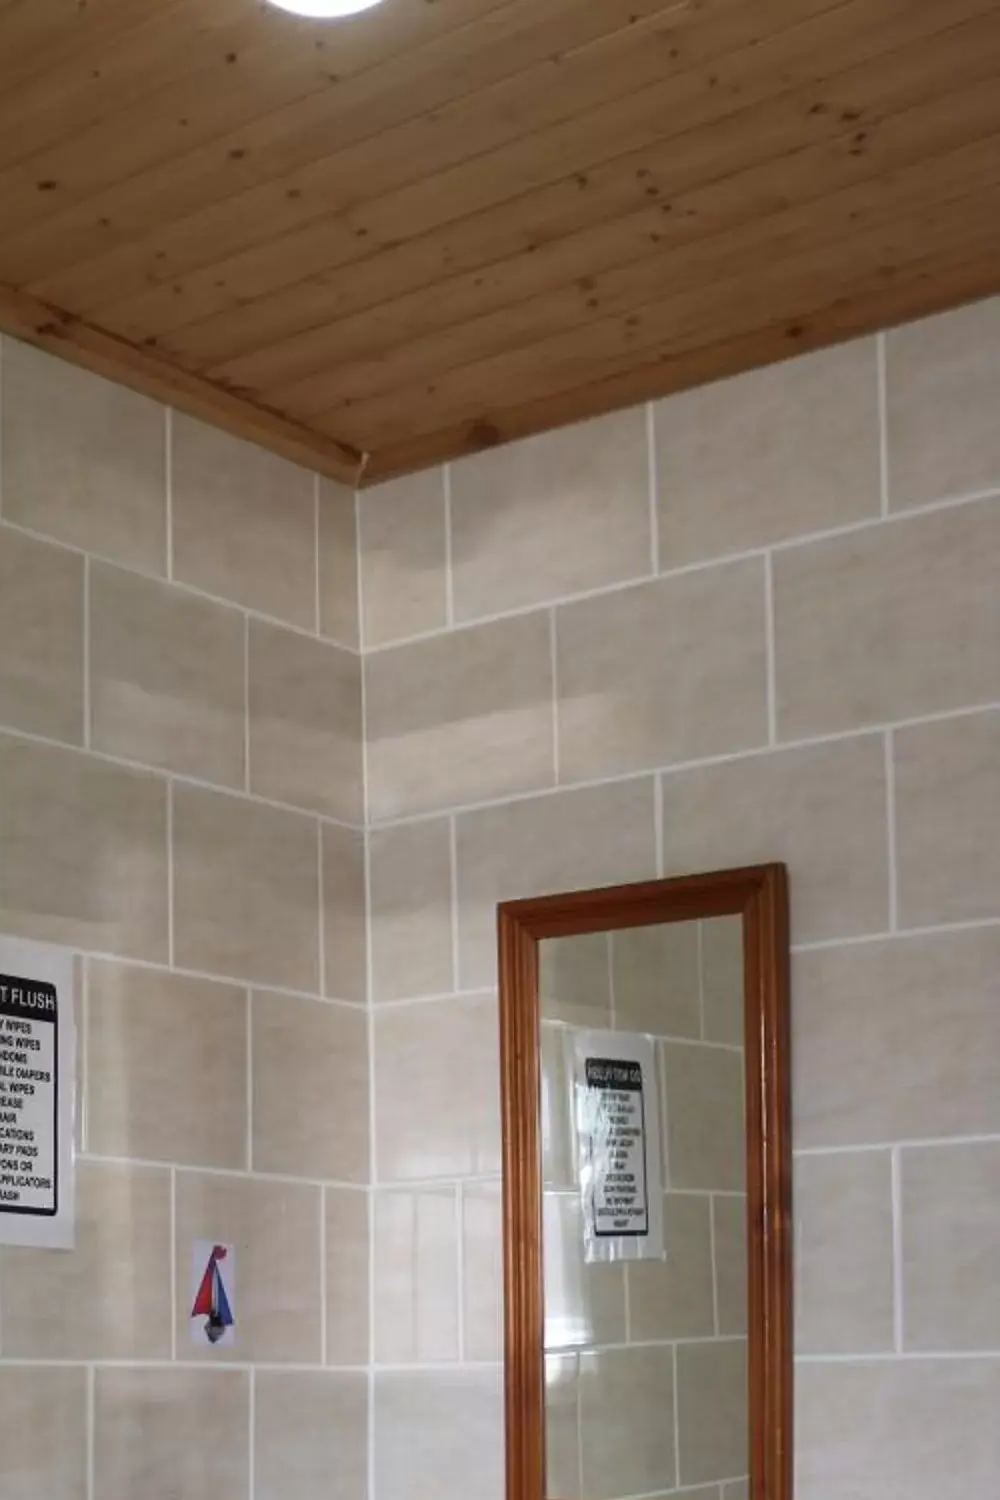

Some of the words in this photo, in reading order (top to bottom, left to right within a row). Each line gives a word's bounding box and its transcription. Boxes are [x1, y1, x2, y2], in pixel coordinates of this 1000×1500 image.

[11, 988, 55, 1010] FLUSH
[6, 1020, 32, 1034] WIPES
[15, 1037, 41, 1051] WIPES
[15, 1067, 51, 1083] DIAPERS
[9, 1083, 35, 1095] WIPES
[15, 1145, 38, 1157] PADS
[20, 1160, 33, 1172] OR
